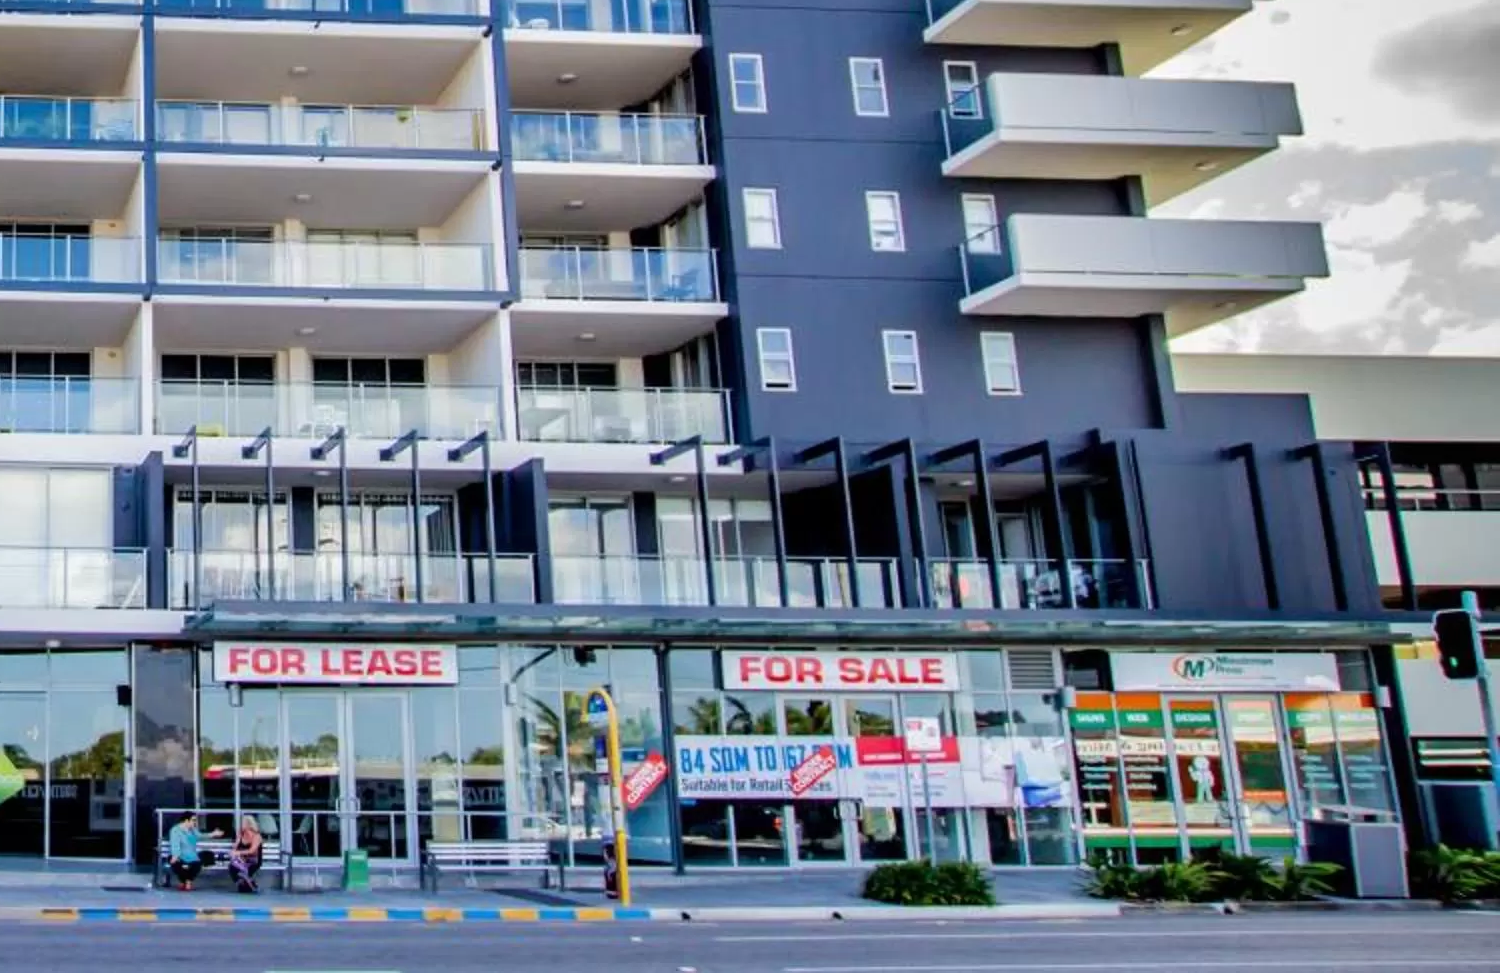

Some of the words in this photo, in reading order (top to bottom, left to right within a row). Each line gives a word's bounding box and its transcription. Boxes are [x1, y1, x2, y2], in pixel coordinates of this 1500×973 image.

[228, 647, 306, 675] FOR
[320, 648, 443, 676] LEASE
[738, 656, 823, 683] FOR
[837, 657, 945, 685] SALE
[680, 747, 705, 774] 84
[753, 744, 777, 772] TO
[681, 777, 729, 793] Suitable
[730, 777, 747, 793] for
[748, 776, 784, 793] Retail
